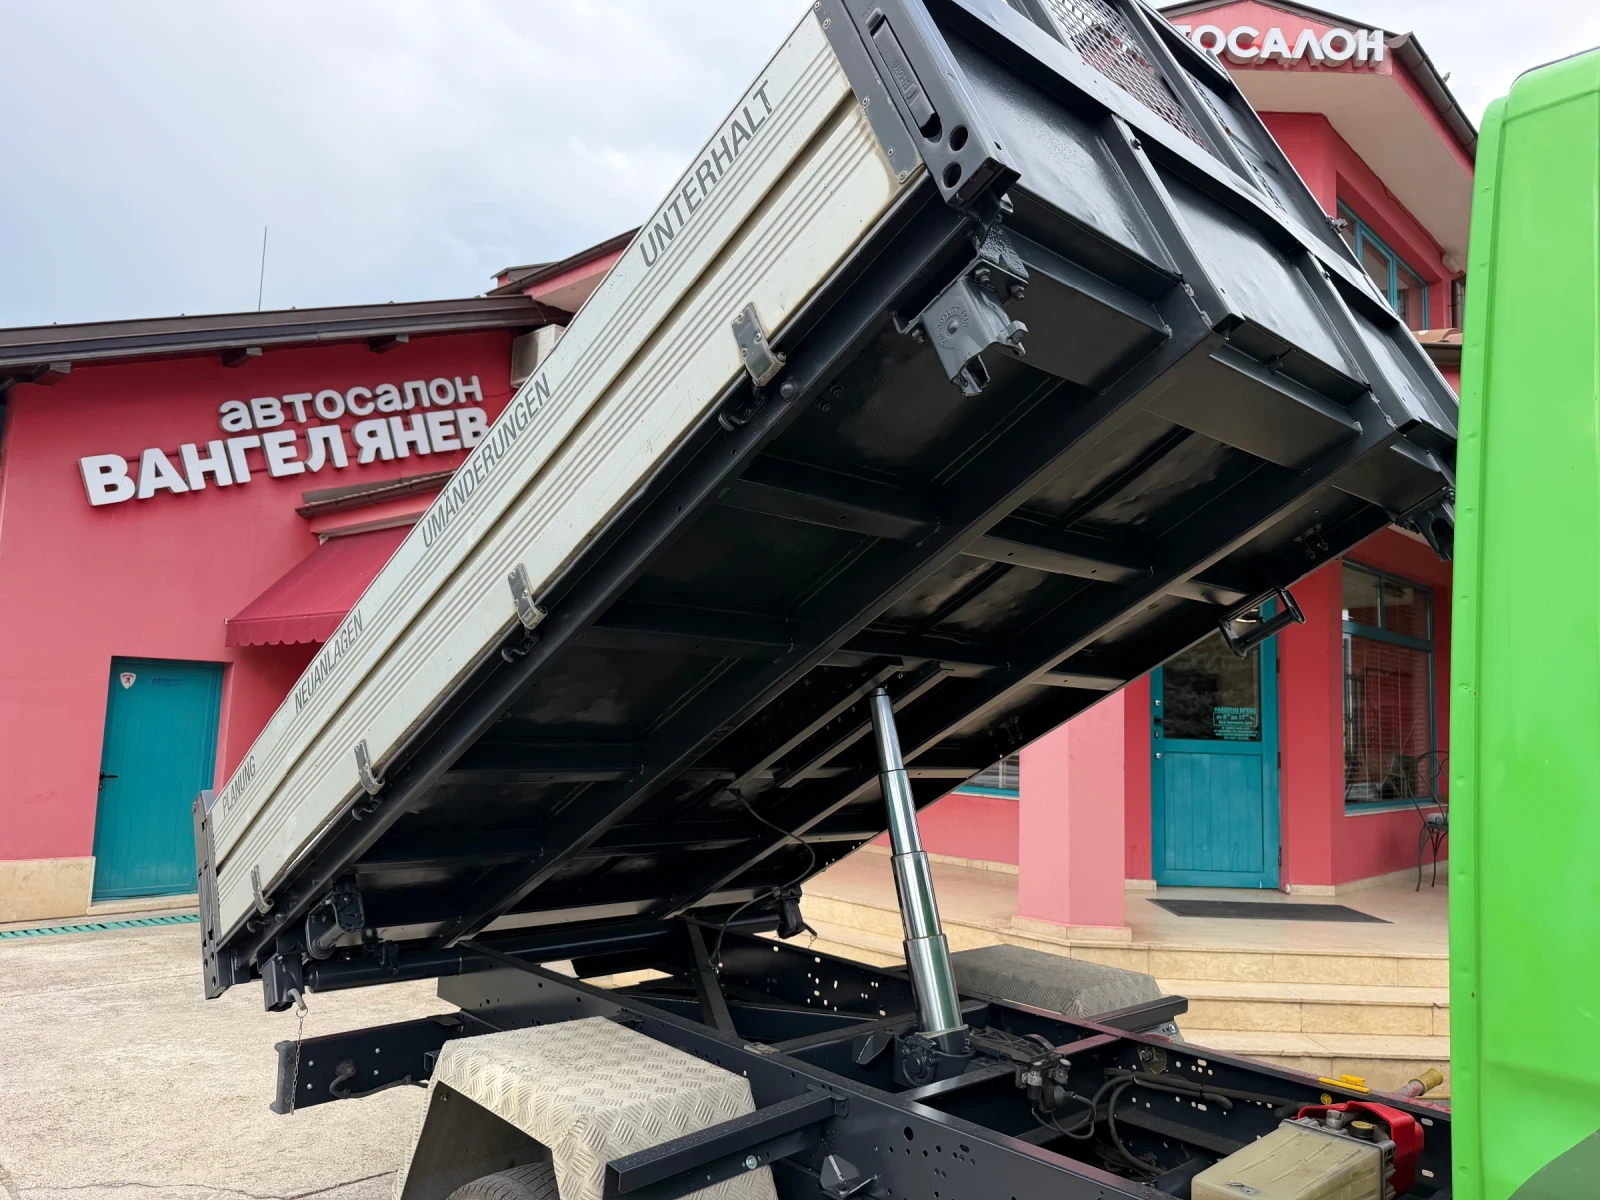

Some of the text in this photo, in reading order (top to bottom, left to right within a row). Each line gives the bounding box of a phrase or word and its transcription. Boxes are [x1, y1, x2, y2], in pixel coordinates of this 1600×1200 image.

[640, 79, 773, 268] UNTERHALT
[937, 306, 960, 331] QUALITY
[217, 375, 483, 433] автосалон
[78, 407, 490, 506] ВАНГЕЛ ЯНЕВ
[422, 372, 552, 548] UMÄNDERUNGEN
[294, 609, 364, 714] NEUANLAGEN
[222, 755, 256, 818] PLANUNG
